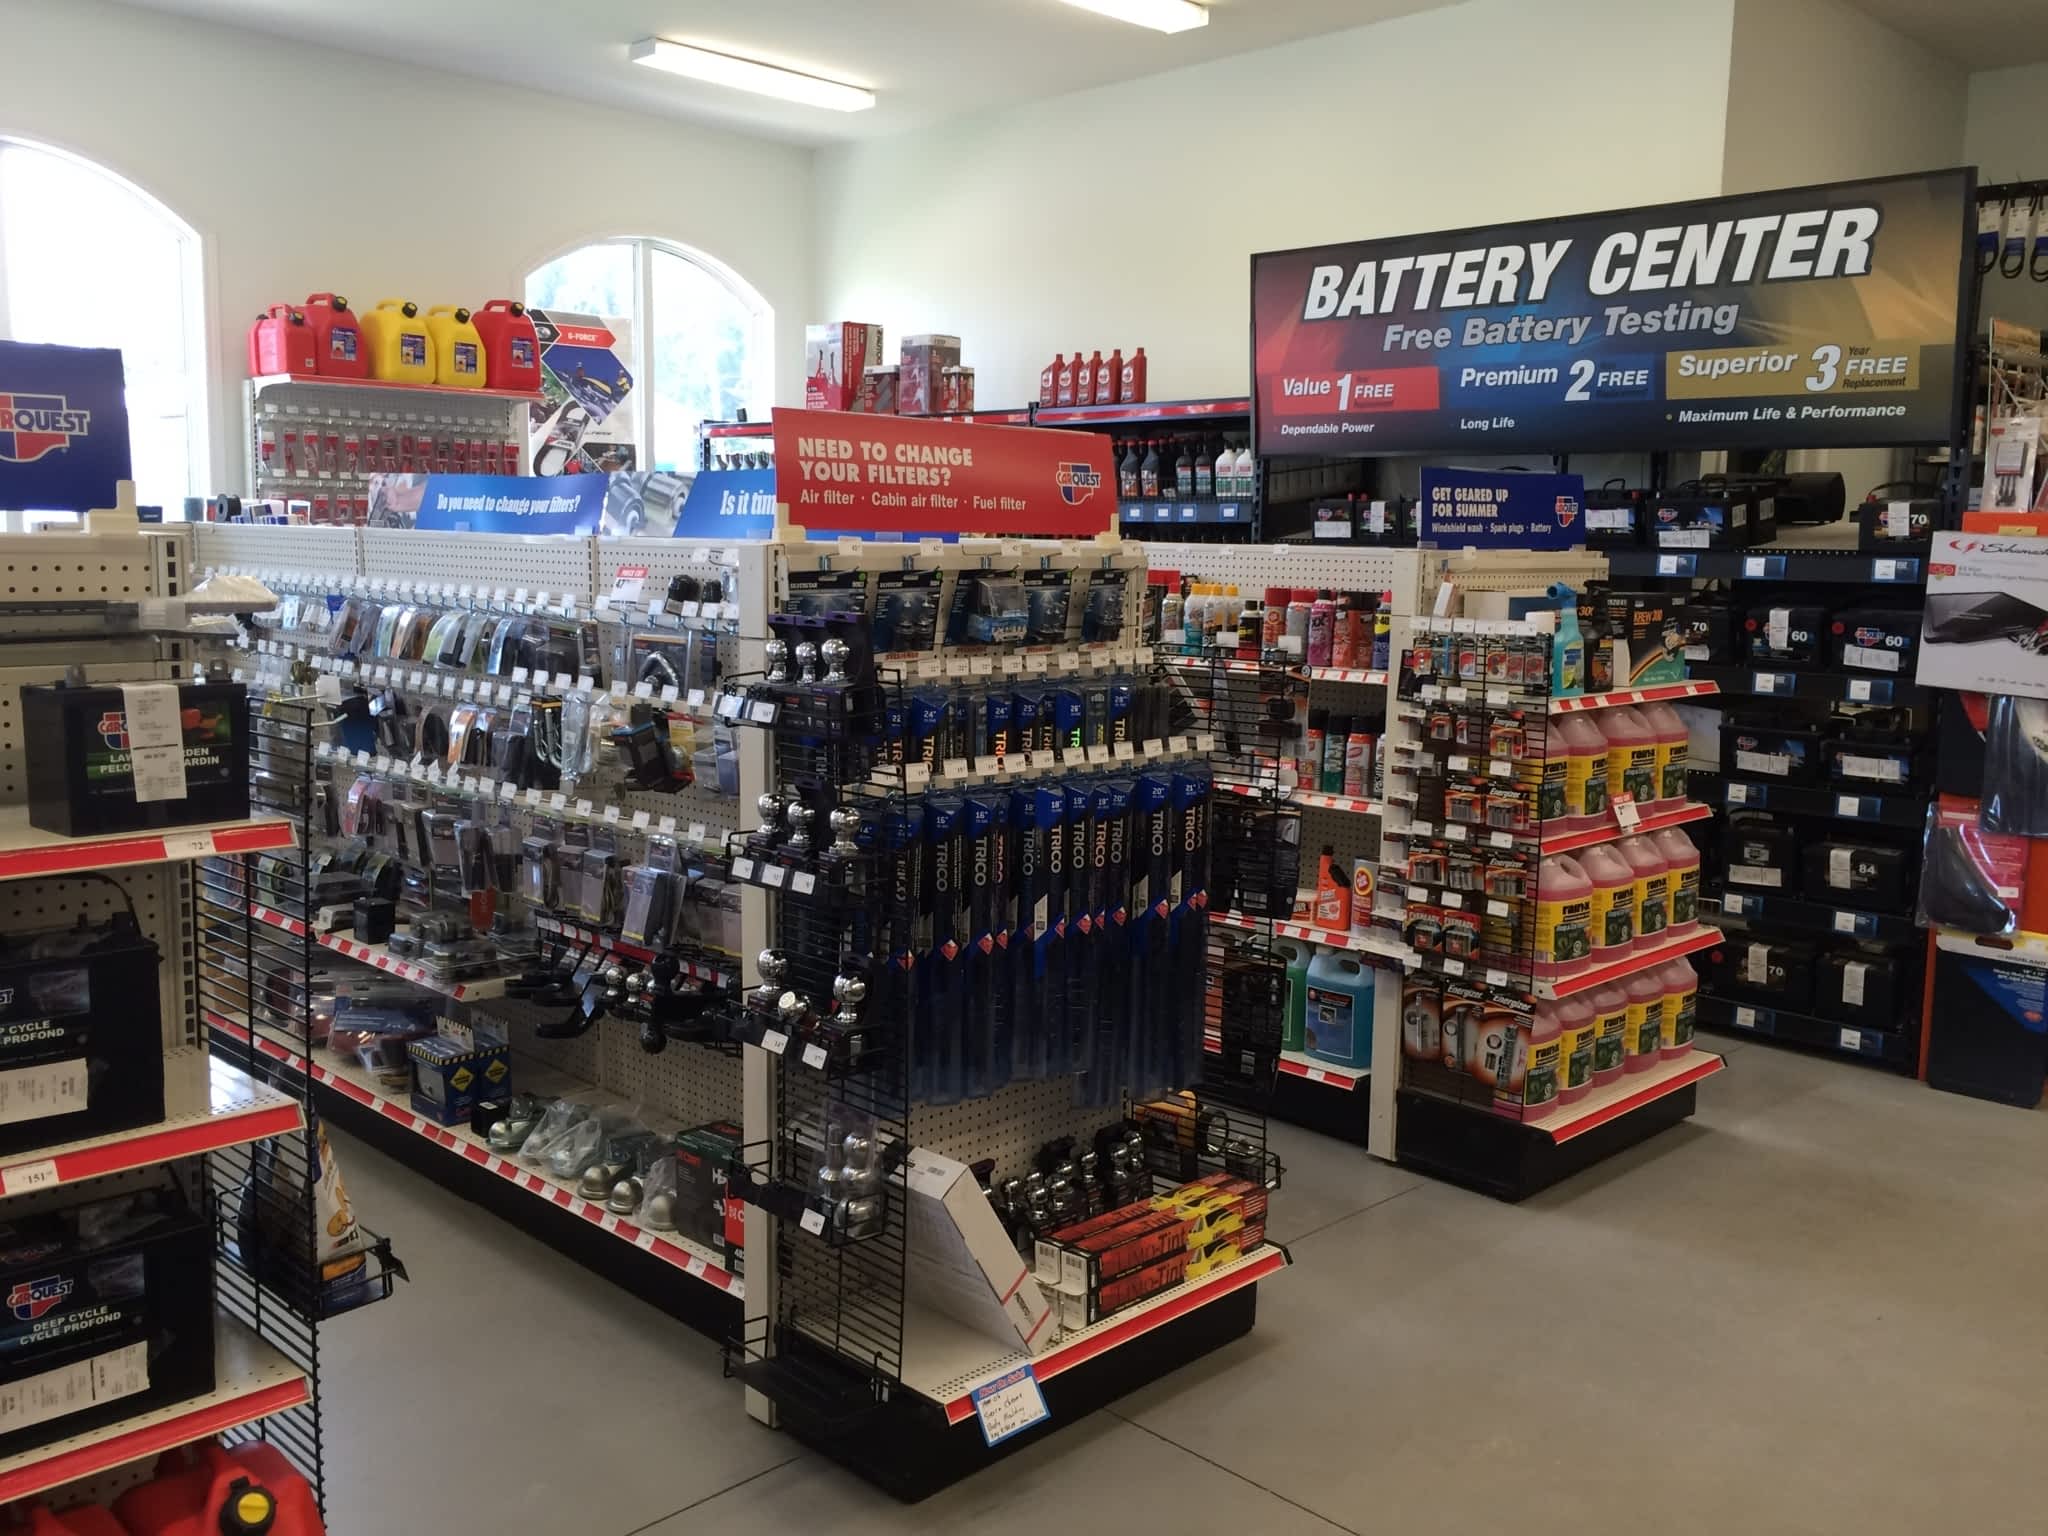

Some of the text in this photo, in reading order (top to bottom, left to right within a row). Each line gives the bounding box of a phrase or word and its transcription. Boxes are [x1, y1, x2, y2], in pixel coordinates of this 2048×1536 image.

[1303, 206, 1880, 320] BATTERY CENTER
[1383, 300, 1740, 352] Free Battery Testing
[1849, 346, 1871, 356] Year
[1678, 344, 1909, 392] Superior 3 FREE
[1283, 376, 1332, 396] Value
[1336, 373, 1352, 411] 1
[1354, 383, 1395, 399] FREE
[1460, 359, 1650, 402] Premium 2 FREE
[1842, 376, 1908, 390] Replacement
[1460, 416, 1516, 431] Long Life
[1678, 404, 1907, 423] Maximum Life & Performance
[1281, 422, 1376, 437] Dependable Power
[798, 436, 973, 467] NEED TO CHANGE
[799, 460, 951, 487] YOUR FILTERS?
[1056, 471, 1100, 488] CARQUEST
[437, 493, 582, 516] Do you need to change your filters?
[720, 489, 776, 515] Is it tim
[800, 488, 1027, 511] Air filter Cabin air filter Fuel filter
[1432, 487, 1509, 503] GET GEARED UP
[1432, 503, 1499, 518] FOR SUMMER
[1911, 513, 1928, 526] 70
[1432, 522, 1552, 535] Windshield wash Spark plugs Battery
[1692, 622, 1707, 632] 70
[1791, 630, 1808, 642] 60
[1885, 635, 1903, 647] 60
[1114, 717, 1125, 743] TRI
[184, 756, 220, 767] ARDIN
[922, 736, 935, 774] TRIC
[1152, 810, 1164, 857] TRICO
[1185, 806, 1196, 852] TRICO
[1023, 828, 1034, 876] TRICO
[1051, 824, 1062, 874] TRICO
[1073, 820, 1086, 869] TRICO
[1095, 820, 1107, 868] TRICO
[1111, 817, 1124, 865] TRICO
[936, 841, 949, 892] TRICO
[975, 836, 988, 887] TRICO
[1858, 863, 1876, 875] 84
[1768, 965, 1784, 977] 70
[1447, 984, 1484, 999] Energizer
[1493, 994, 1532, 1010] Energizer
[3, 1028, 65, 1045] PROFOND
[9, 1020, 51, 1035] CYCLE
[20, 1311, 122, 1345] CYCLE PROFOND
[33, 1305, 108, 1332] DEEP CYCLE
